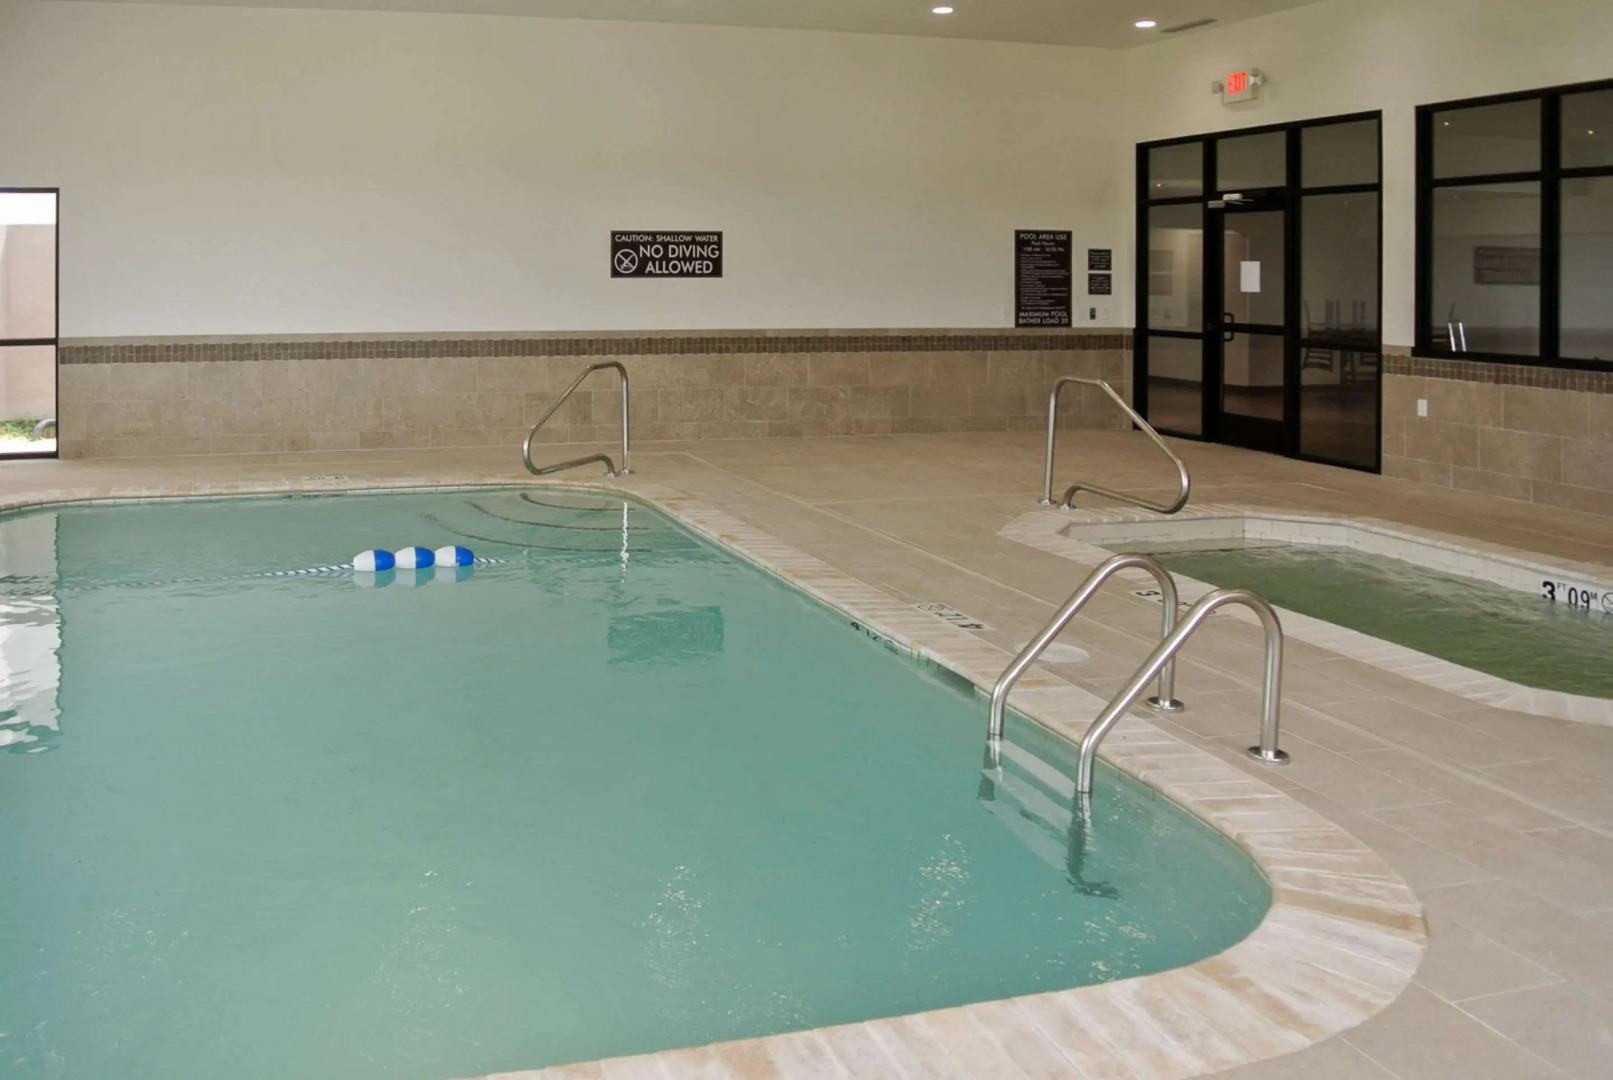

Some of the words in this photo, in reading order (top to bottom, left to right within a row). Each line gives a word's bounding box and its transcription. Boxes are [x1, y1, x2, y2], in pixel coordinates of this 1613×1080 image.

[1227, 71, 1248, 94] EXIT
[615, 234, 653, 242] CAUTION:
[639, 245, 664, 258] NO
[668, 245, 720, 258] DIVING
[645, 260, 713, 274] ALLOWED
